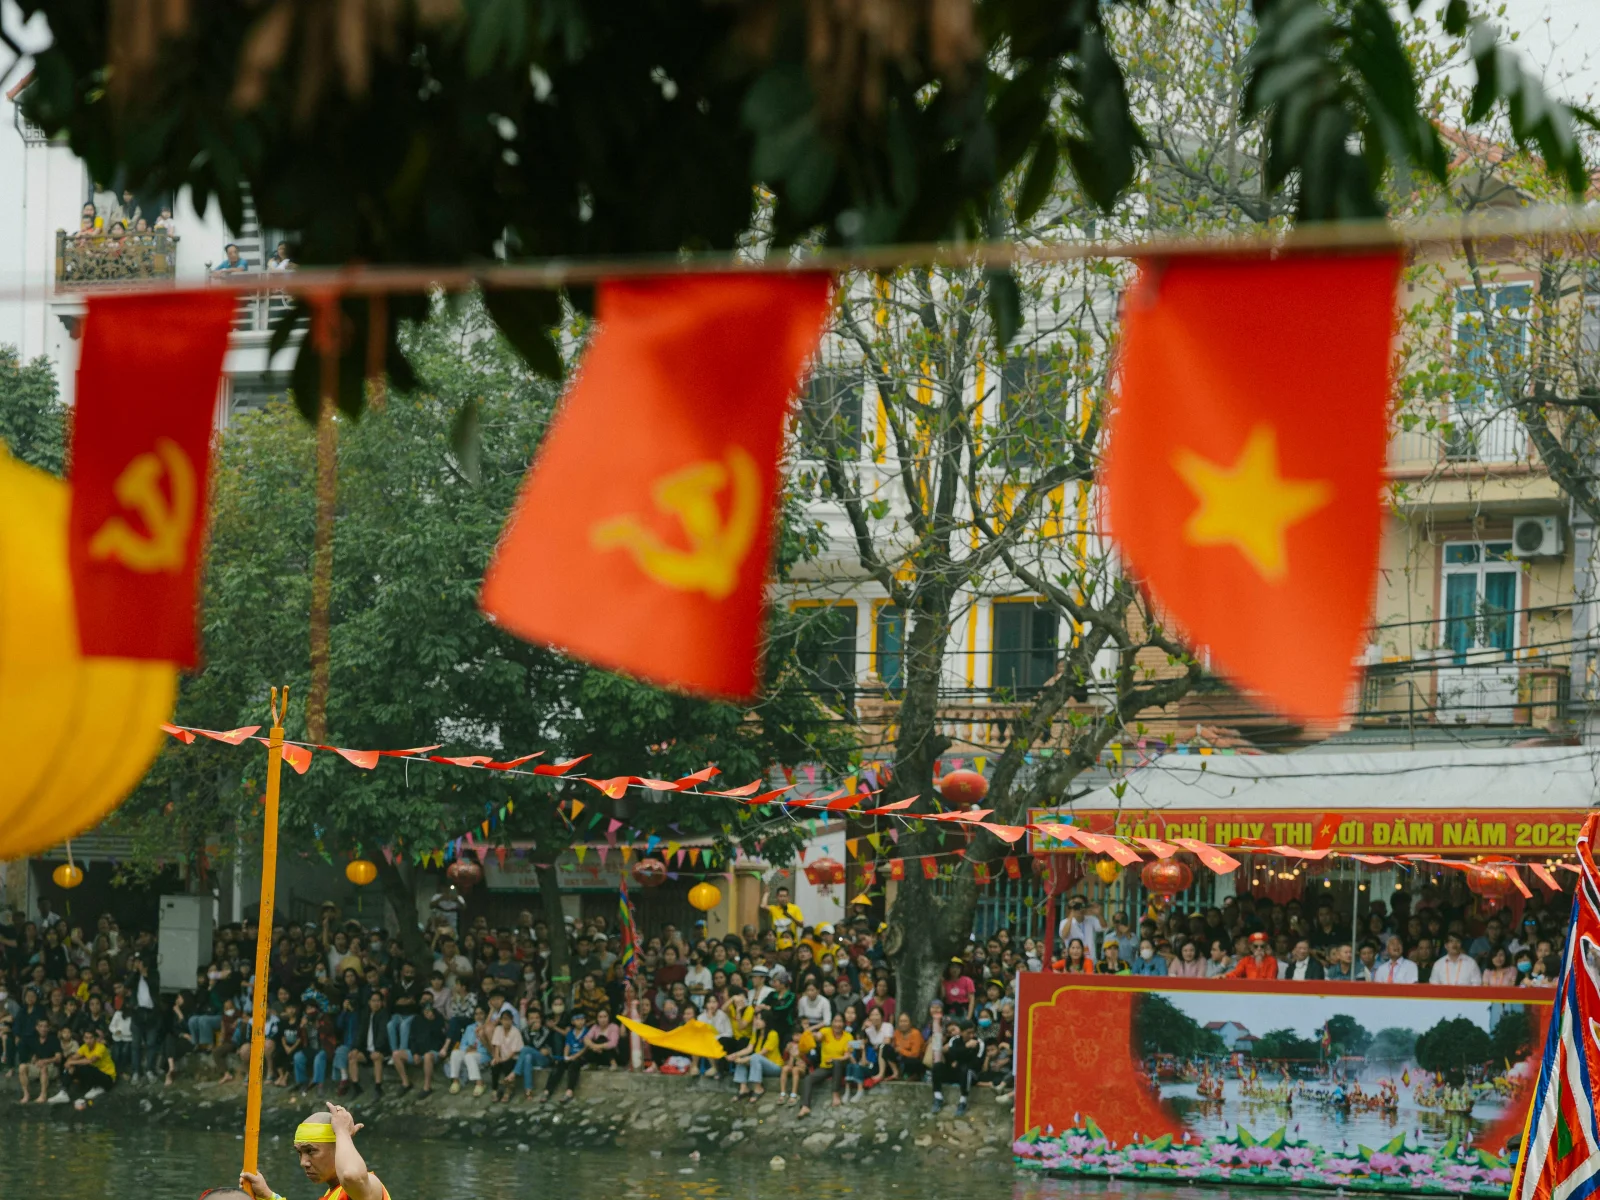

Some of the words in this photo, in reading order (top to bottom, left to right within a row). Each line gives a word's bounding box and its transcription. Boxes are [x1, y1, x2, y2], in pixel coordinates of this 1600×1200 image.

[1165, 816, 1208, 845] CHỈ
[1215, 822, 1265, 845] HUY
[1272, 822, 1312, 845] THI
[1329, 820, 1365, 845] ƠI
[1373, 818, 1434, 846] ĐĂM
[1442, 818, 1506, 846] NĂM
[1515, 822, 1583, 846] 2025
